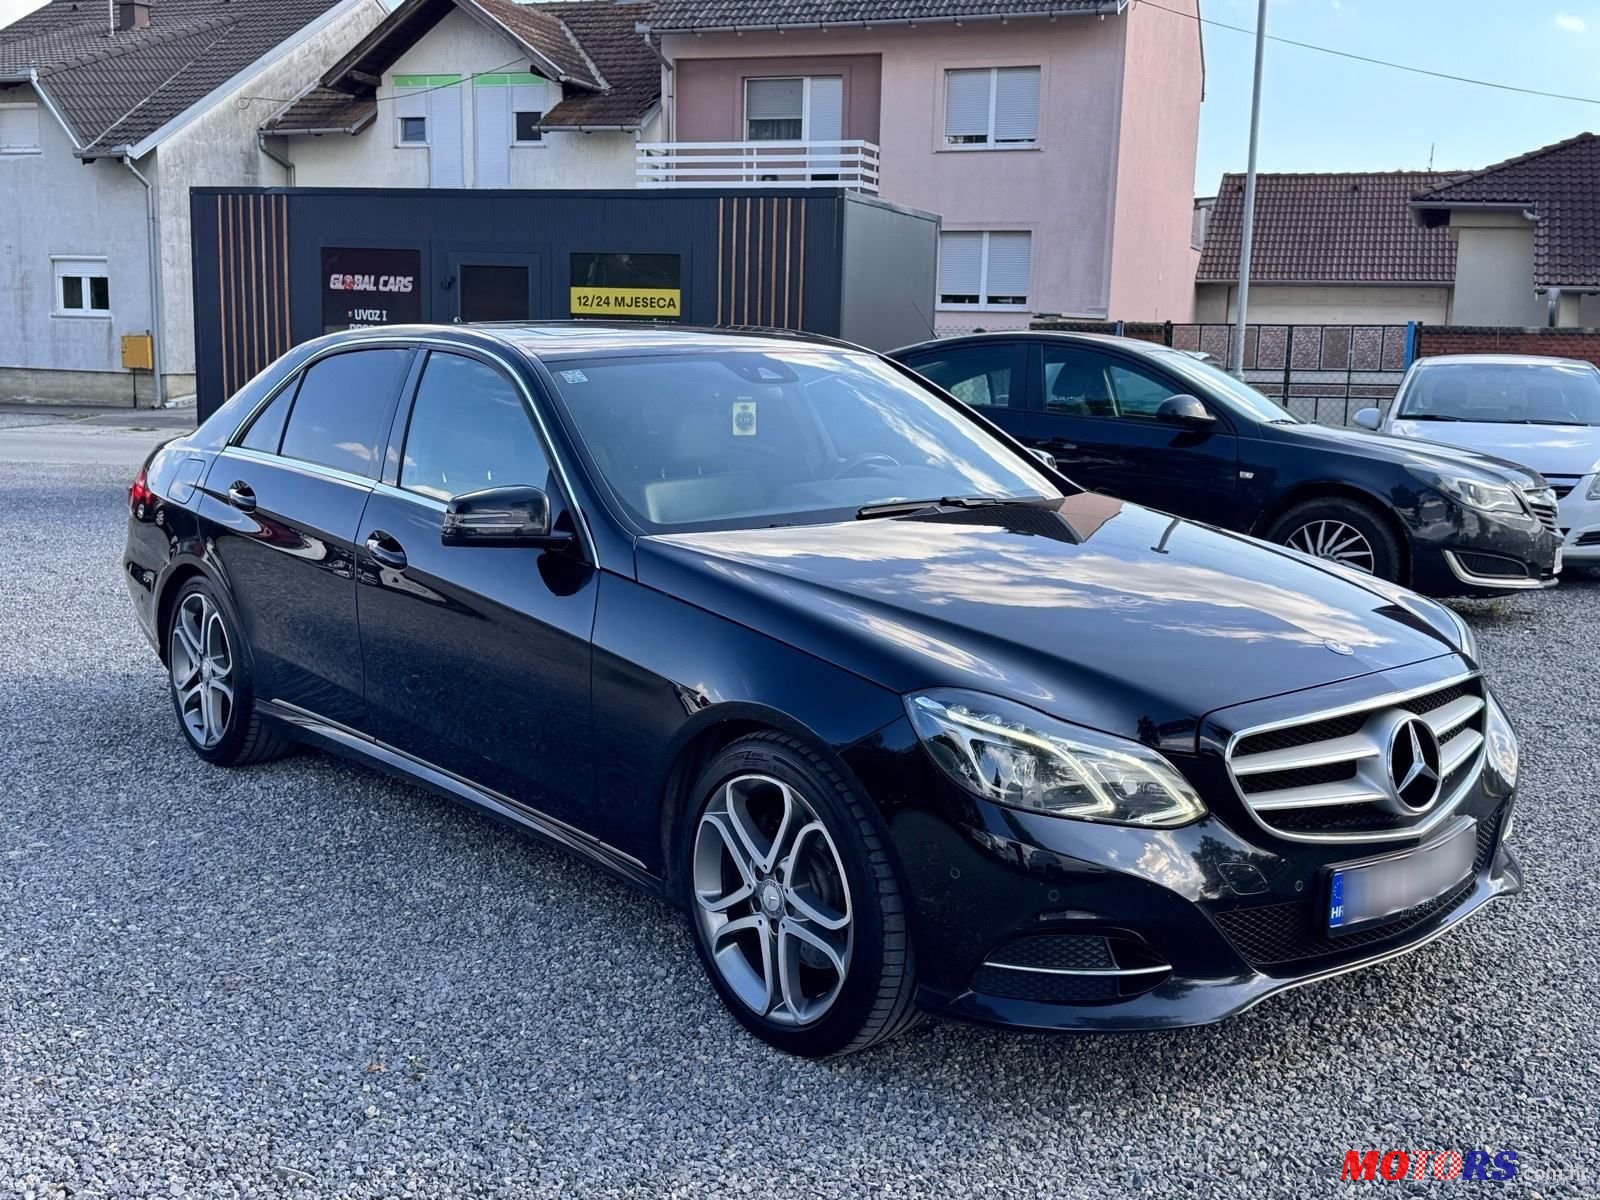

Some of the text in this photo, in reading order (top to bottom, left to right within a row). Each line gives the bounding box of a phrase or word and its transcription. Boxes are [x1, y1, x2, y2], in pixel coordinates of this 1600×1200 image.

[330, 273, 414, 292] GLOBAL CARS
[577, 295, 677, 309] 12/24 MJESECA
[354, 308, 381, 320] UVOZ
